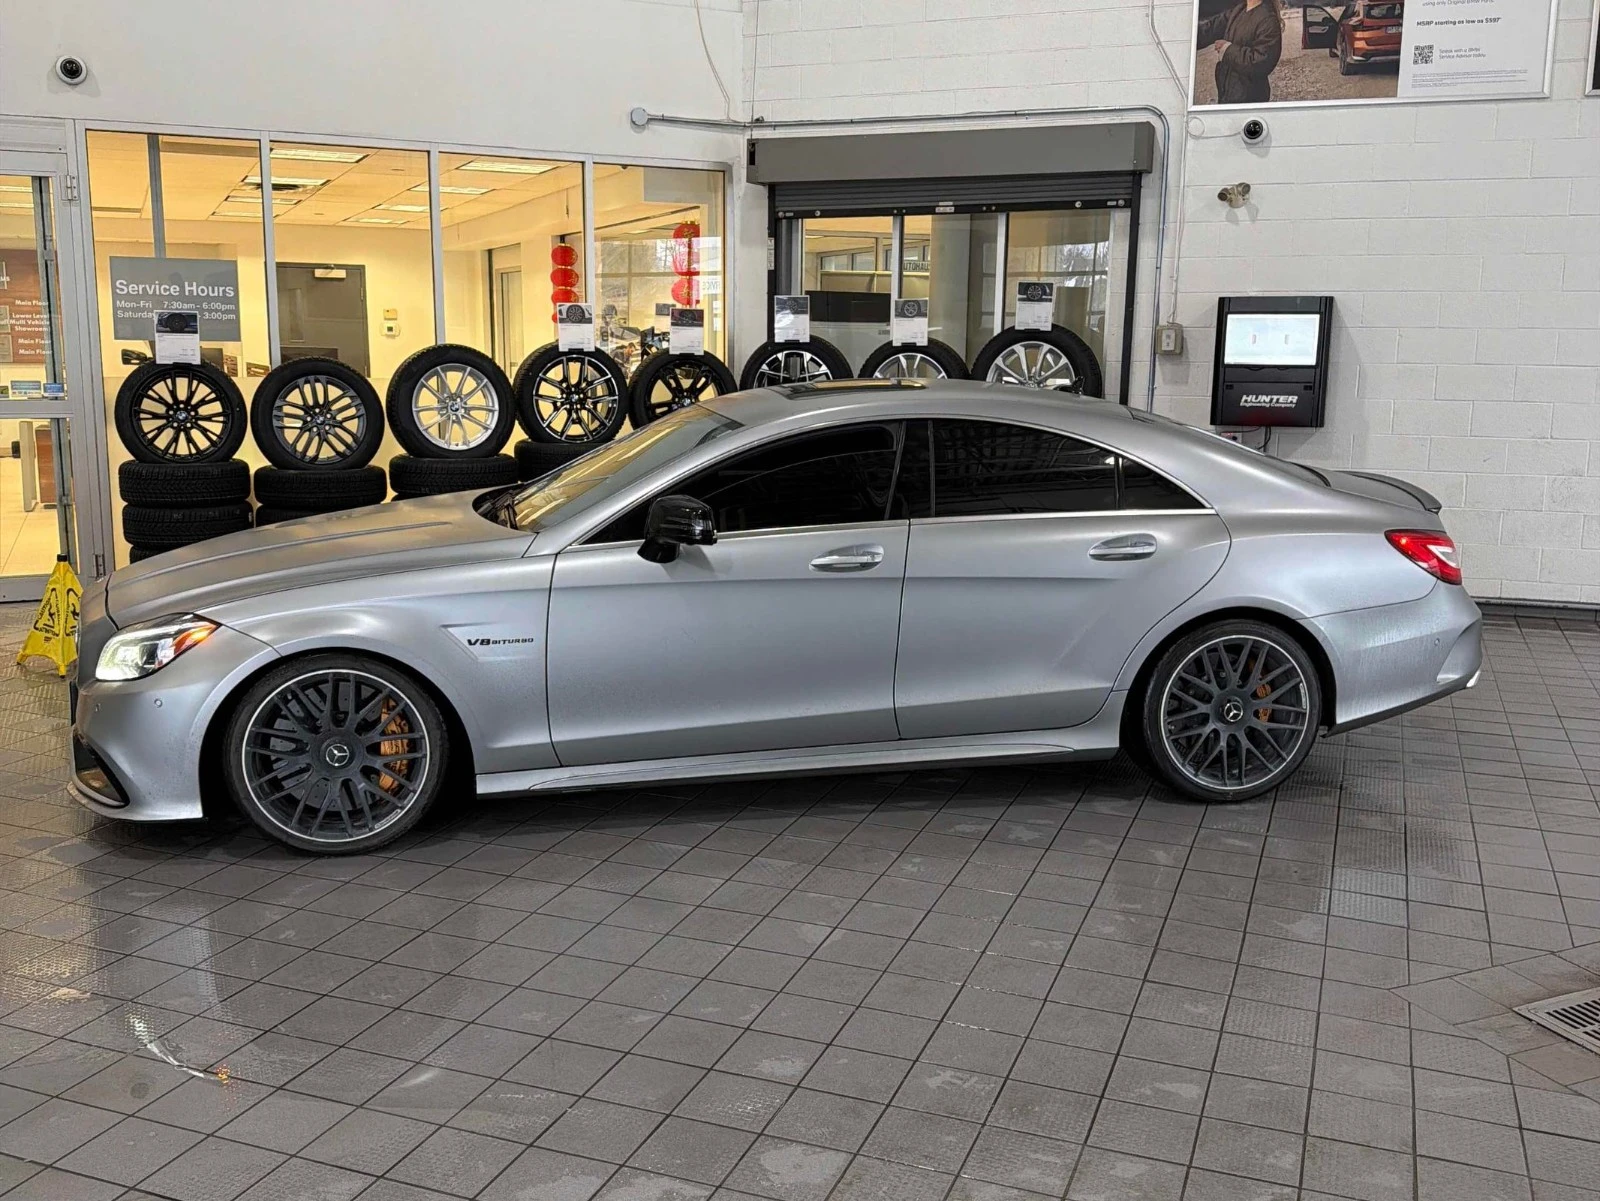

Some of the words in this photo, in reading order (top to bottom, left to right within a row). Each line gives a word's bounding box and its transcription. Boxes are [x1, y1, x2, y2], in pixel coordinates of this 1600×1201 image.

[902, 262, 929, 271] UTOHAU
[115, 279, 180, 296] Service
[184, 281, 235, 297] Hours
[116, 300, 153, 309] Mon-Fri
[163, 301, 196, 310] 7:30am
[202, 302, 235, 311] 6:00pm
[117, 310, 156, 320] Saturday
[203, 312, 236, 321] 3:00pm
[1241, 395, 1298, 403] HUNTER
